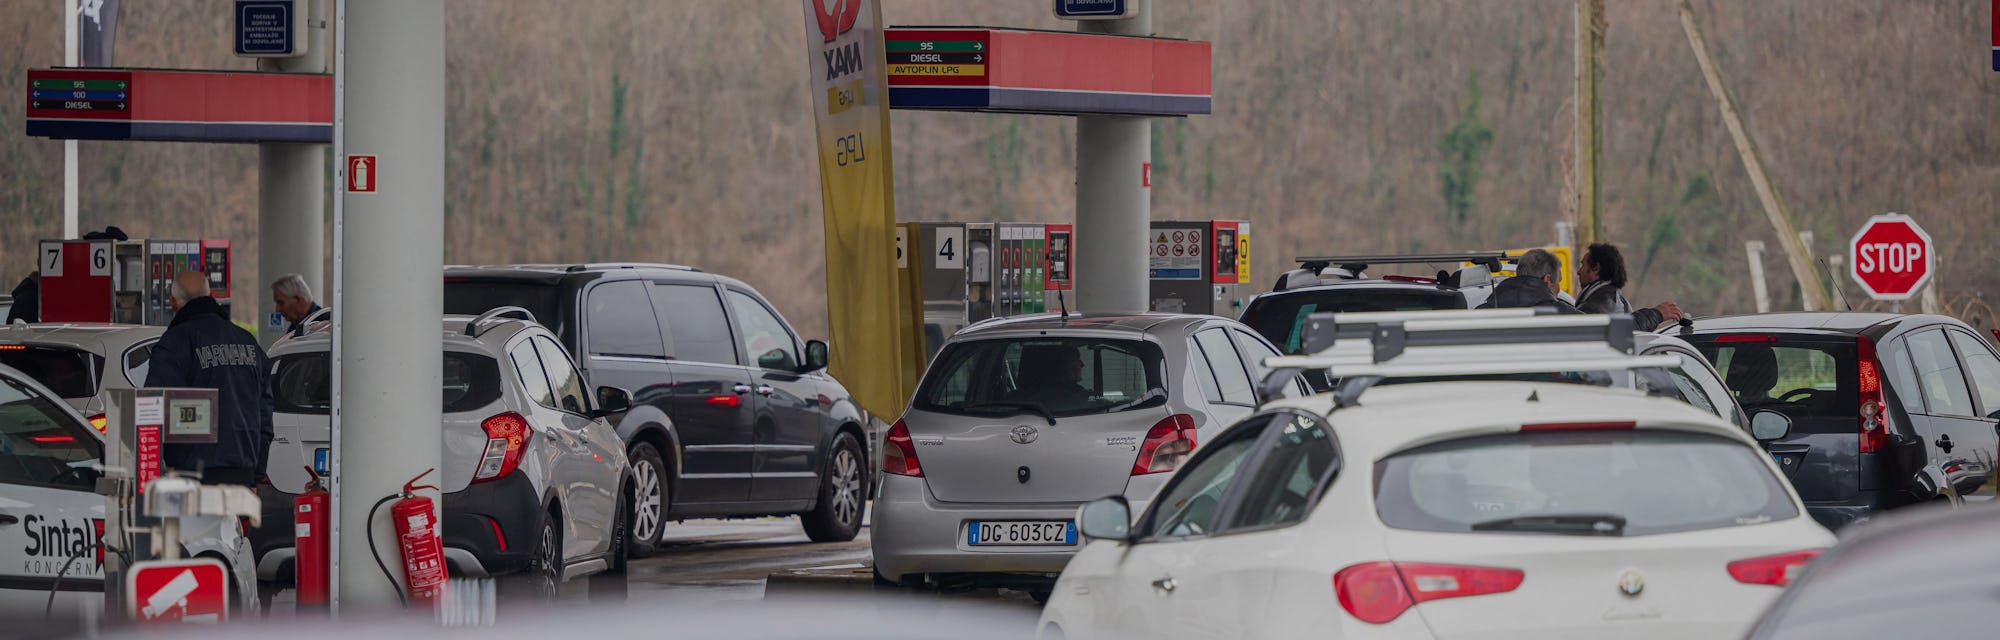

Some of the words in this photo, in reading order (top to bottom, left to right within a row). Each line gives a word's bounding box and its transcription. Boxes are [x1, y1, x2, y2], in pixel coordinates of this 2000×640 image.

[920, 42, 934, 51] 95
[910, 53, 943, 63] DIESEL
[894, 65, 939, 74] AVTOPLIN
[941, 65, 960, 74] LPG
[73, 80, 85, 89] 95
[73, 91, 86, 99] 100
[65, 101, 93, 109] DIESEL
[938, 237, 955, 261] 4
[47, 248, 60, 270] 7
[94, 248, 106, 270] 6
[1860, 242, 1922, 274] STOP
[24, 514, 92, 558] Sintal
[981, 523, 1002, 542] DG
[1009, 523, 1064, 542] 603CZ
